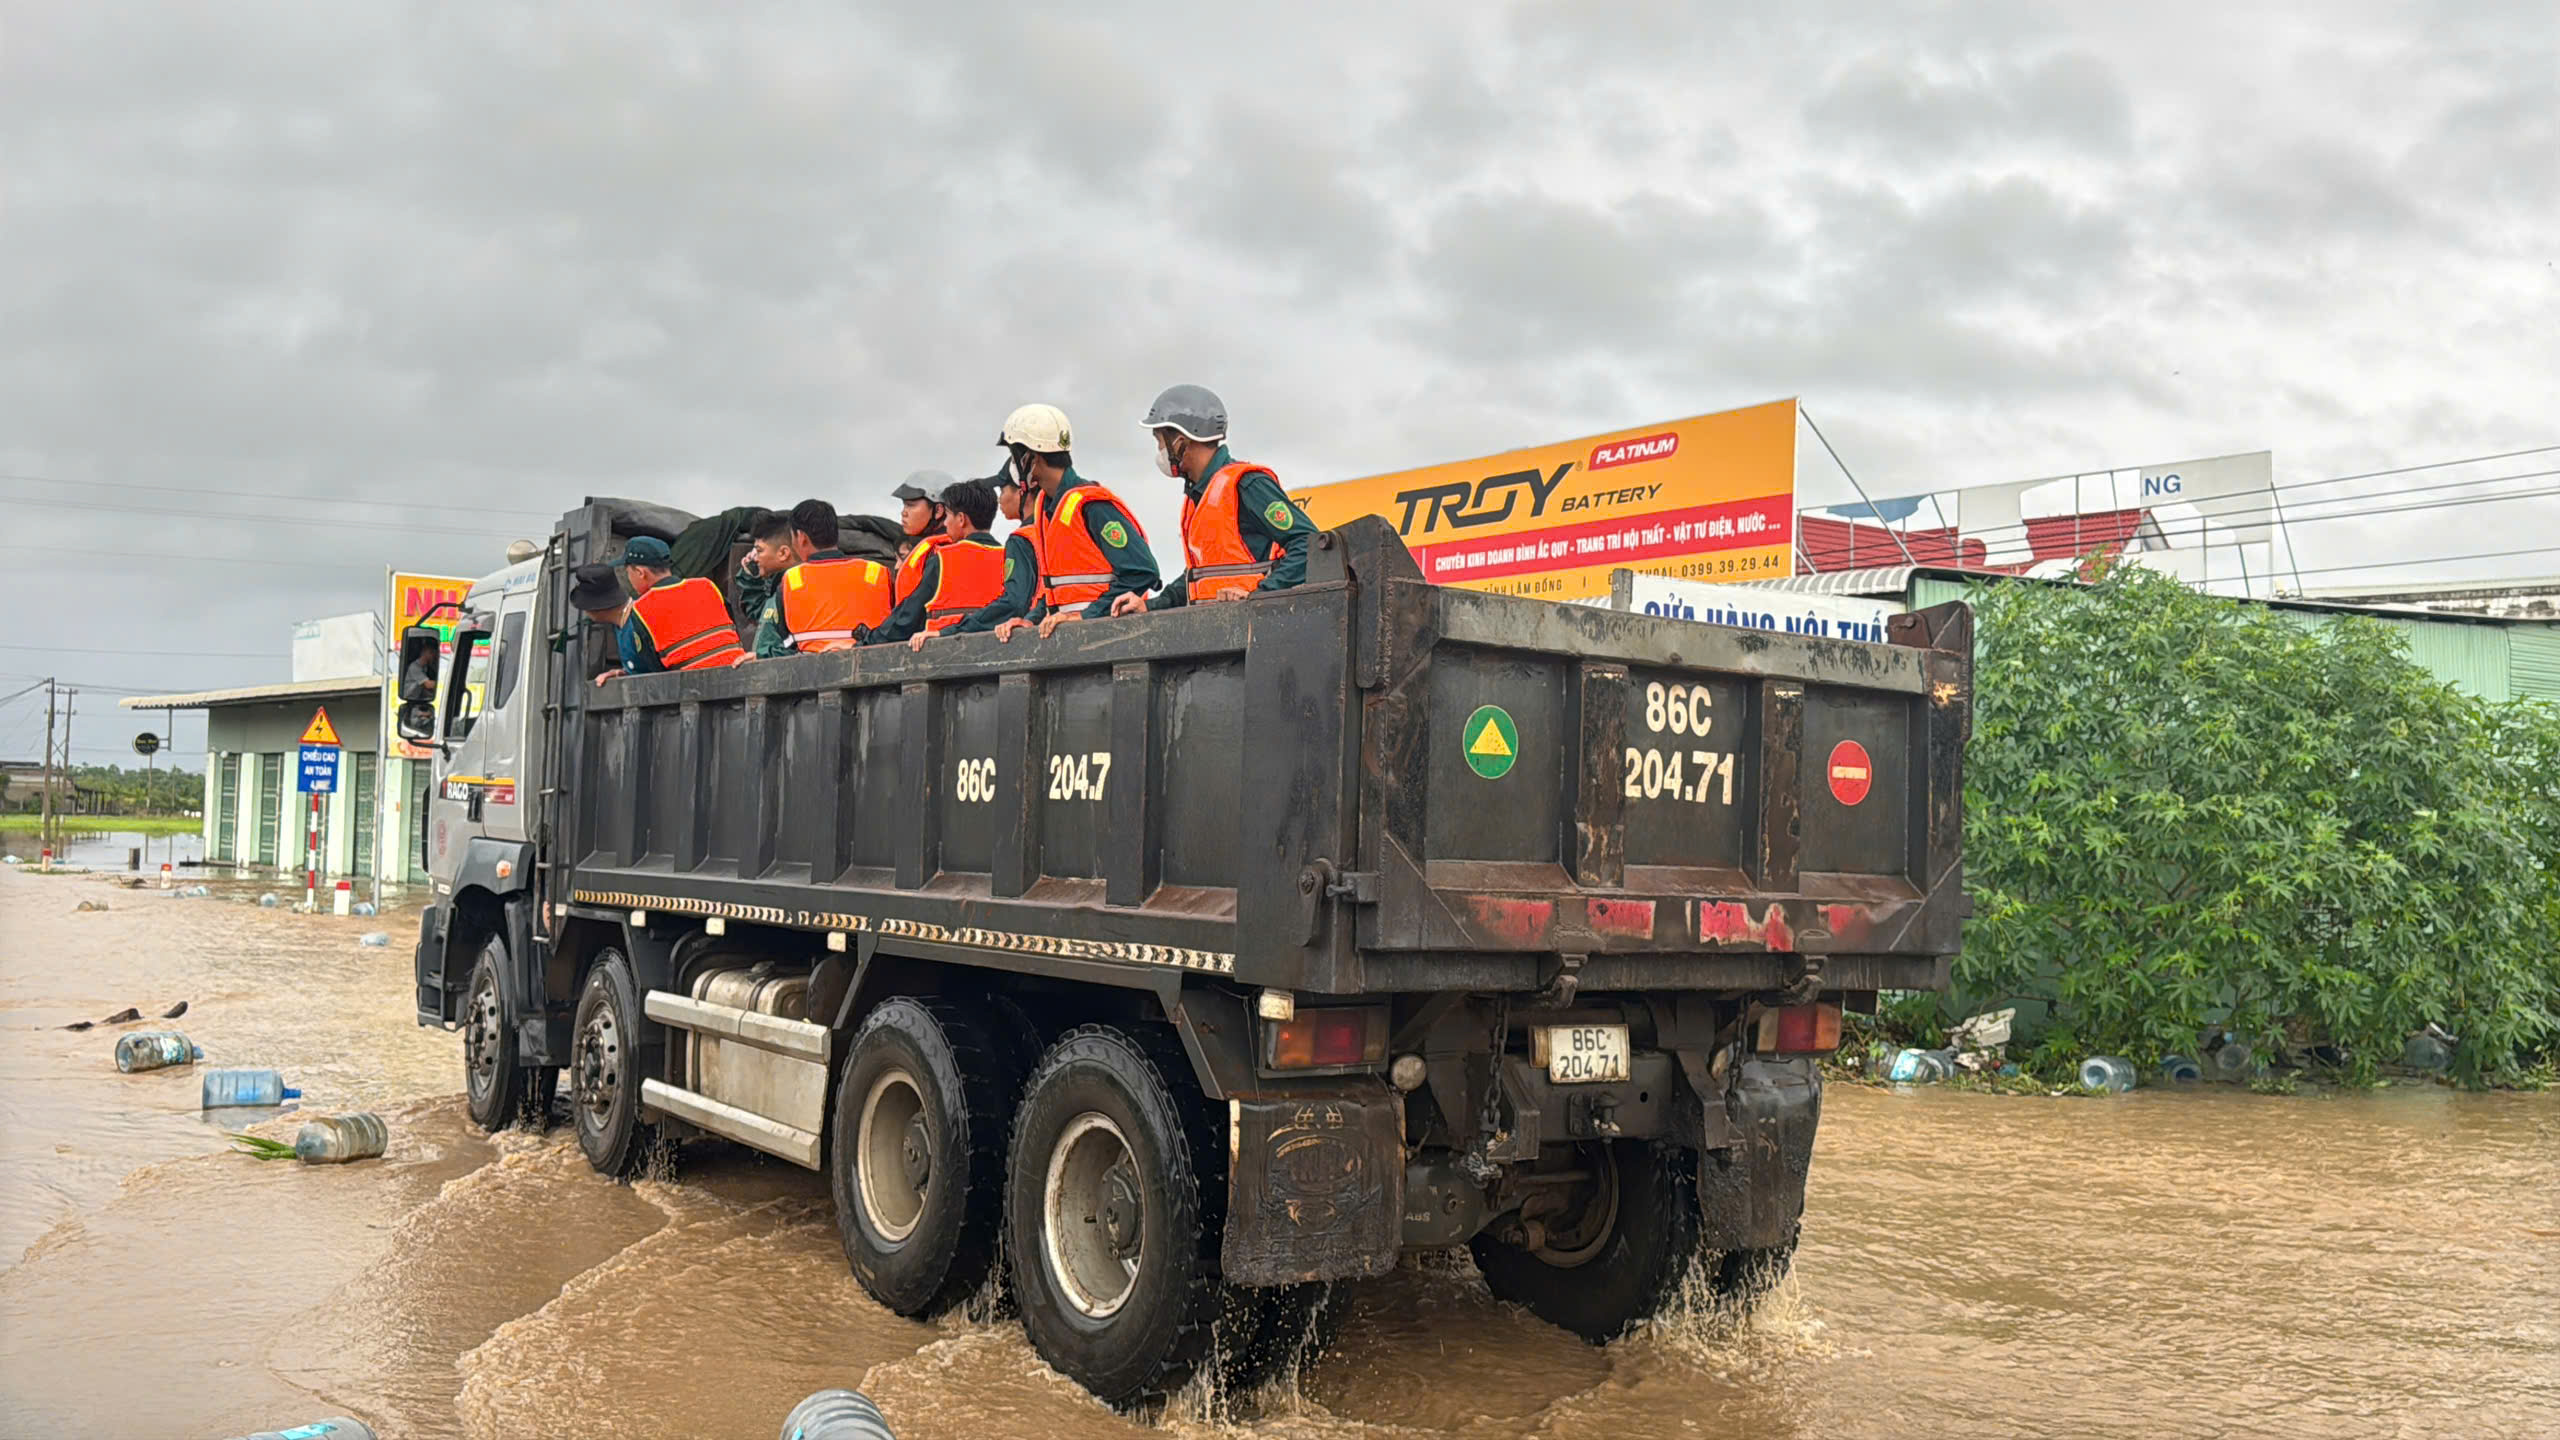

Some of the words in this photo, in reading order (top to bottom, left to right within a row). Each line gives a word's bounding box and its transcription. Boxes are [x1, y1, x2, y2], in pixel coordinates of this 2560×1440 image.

[1596, 437, 1675, 465] PLATINUM
[1395, 462, 1575, 536] TROY
[1560, 482, 1663, 513] BATTERY
[2144, 474, 2182, 496] NG
[1467, 551, 1486, 567] KINH
[1487, 547, 1515, 566] DOANH
[1515, 544, 1536, 562] BÌNH
[1551, 540, 1568, 558] QUY
[1576, 535, 1605, 554] TRANG
[1607, 529, 1621, 550] TRÍ
[1681, 554, 1780, 579] 0399.39.29.44
[1646, 682, 1713, 737] 86C
[304, 764, 314, 775] AN
[957, 757, 996, 802] 86C
[1049, 752, 1112, 801] 204.7
[1625, 747, 1735, 805] 204.71
[1572, 1028, 1607, 1052] 86C
